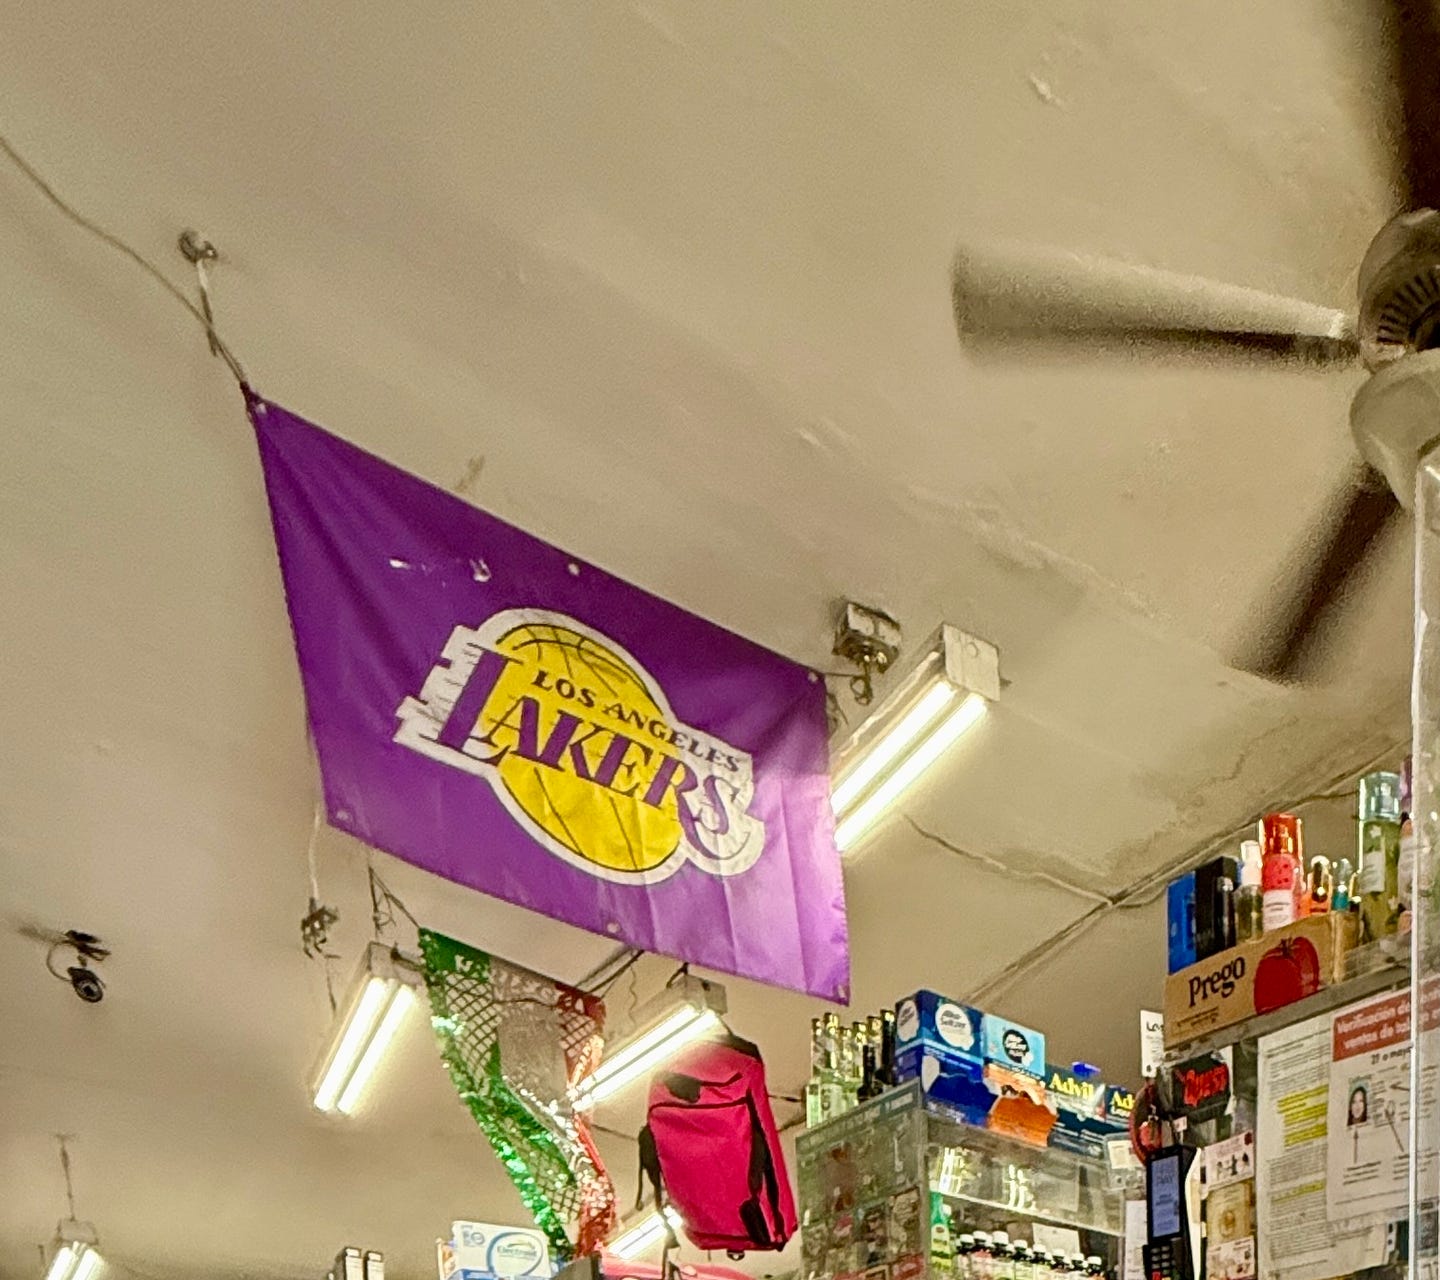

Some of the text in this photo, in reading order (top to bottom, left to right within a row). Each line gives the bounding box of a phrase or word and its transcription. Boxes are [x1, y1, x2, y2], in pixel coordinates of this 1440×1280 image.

[428, 643, 752, 858] LAKERS
[532, 670, 740, 772] LOS ANGELES
[1188, 955, 1246, 1008] Prego
[1049, 1072, 1095, 1101] Advil
